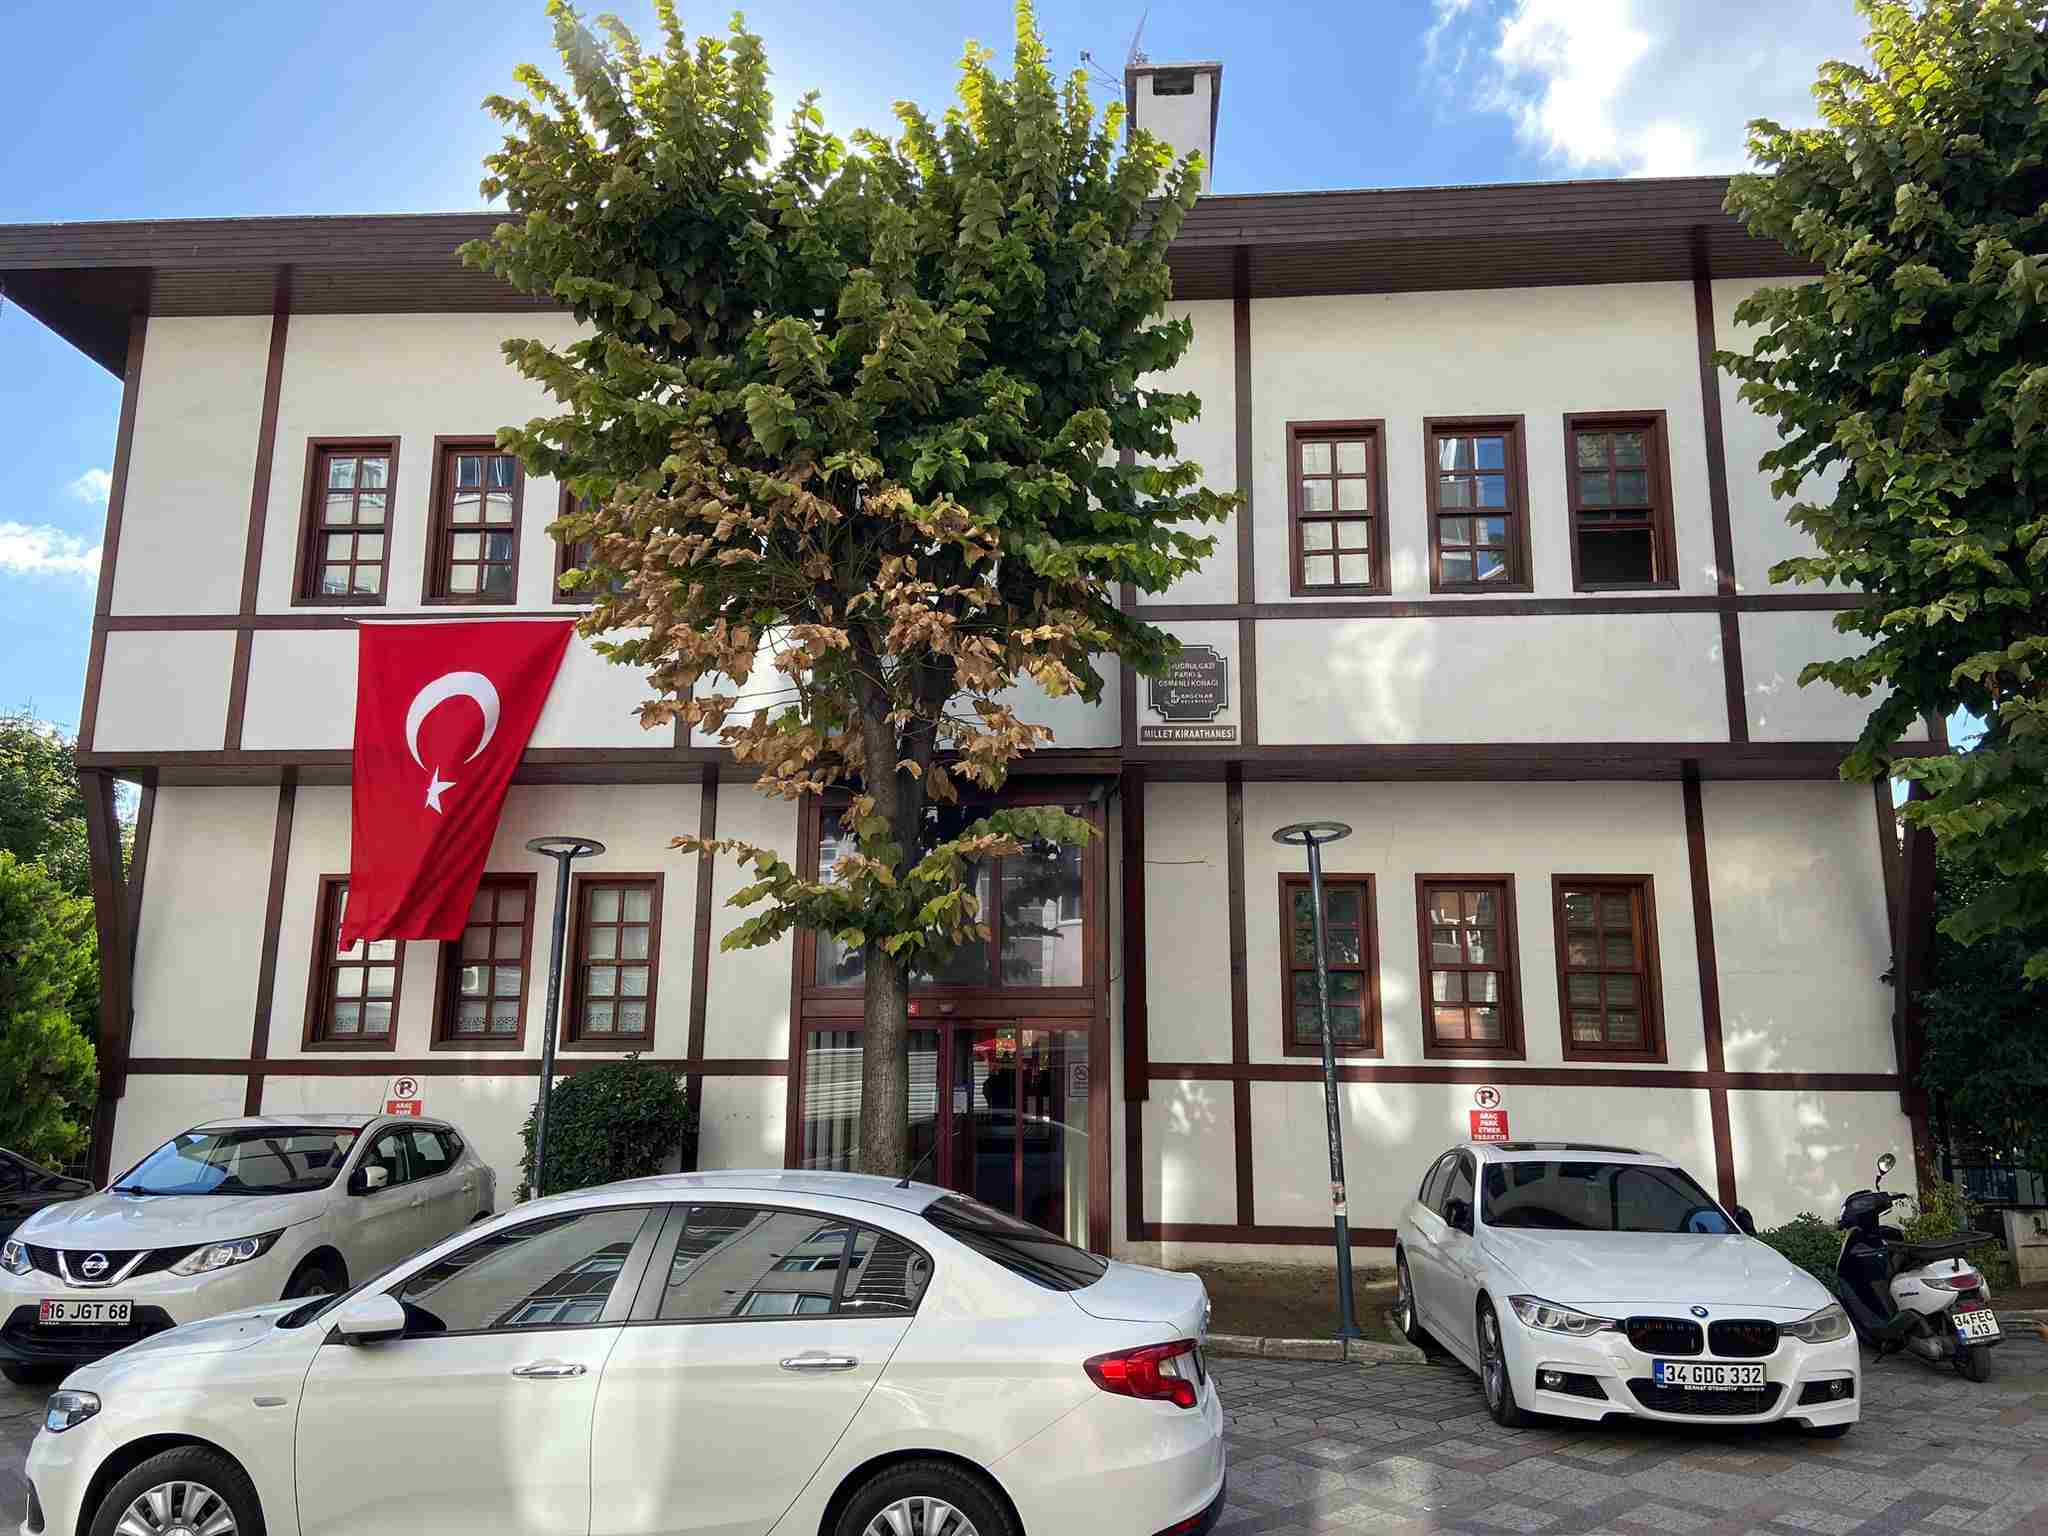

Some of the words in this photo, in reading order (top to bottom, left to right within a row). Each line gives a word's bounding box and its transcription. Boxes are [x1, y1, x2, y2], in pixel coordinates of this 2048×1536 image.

[49, 1303, 65, 1319] 16
[70, 1303, 104, 1319] JGT
[108, 1304, 128, 1319] 68
[1972, 1323, 1990, 1336] 413
[1665, 1365, 1687, 1383] 34
[1692, 1366, 1725, 1384] GDG
[1730, 1367, 1761, 1385] 332
